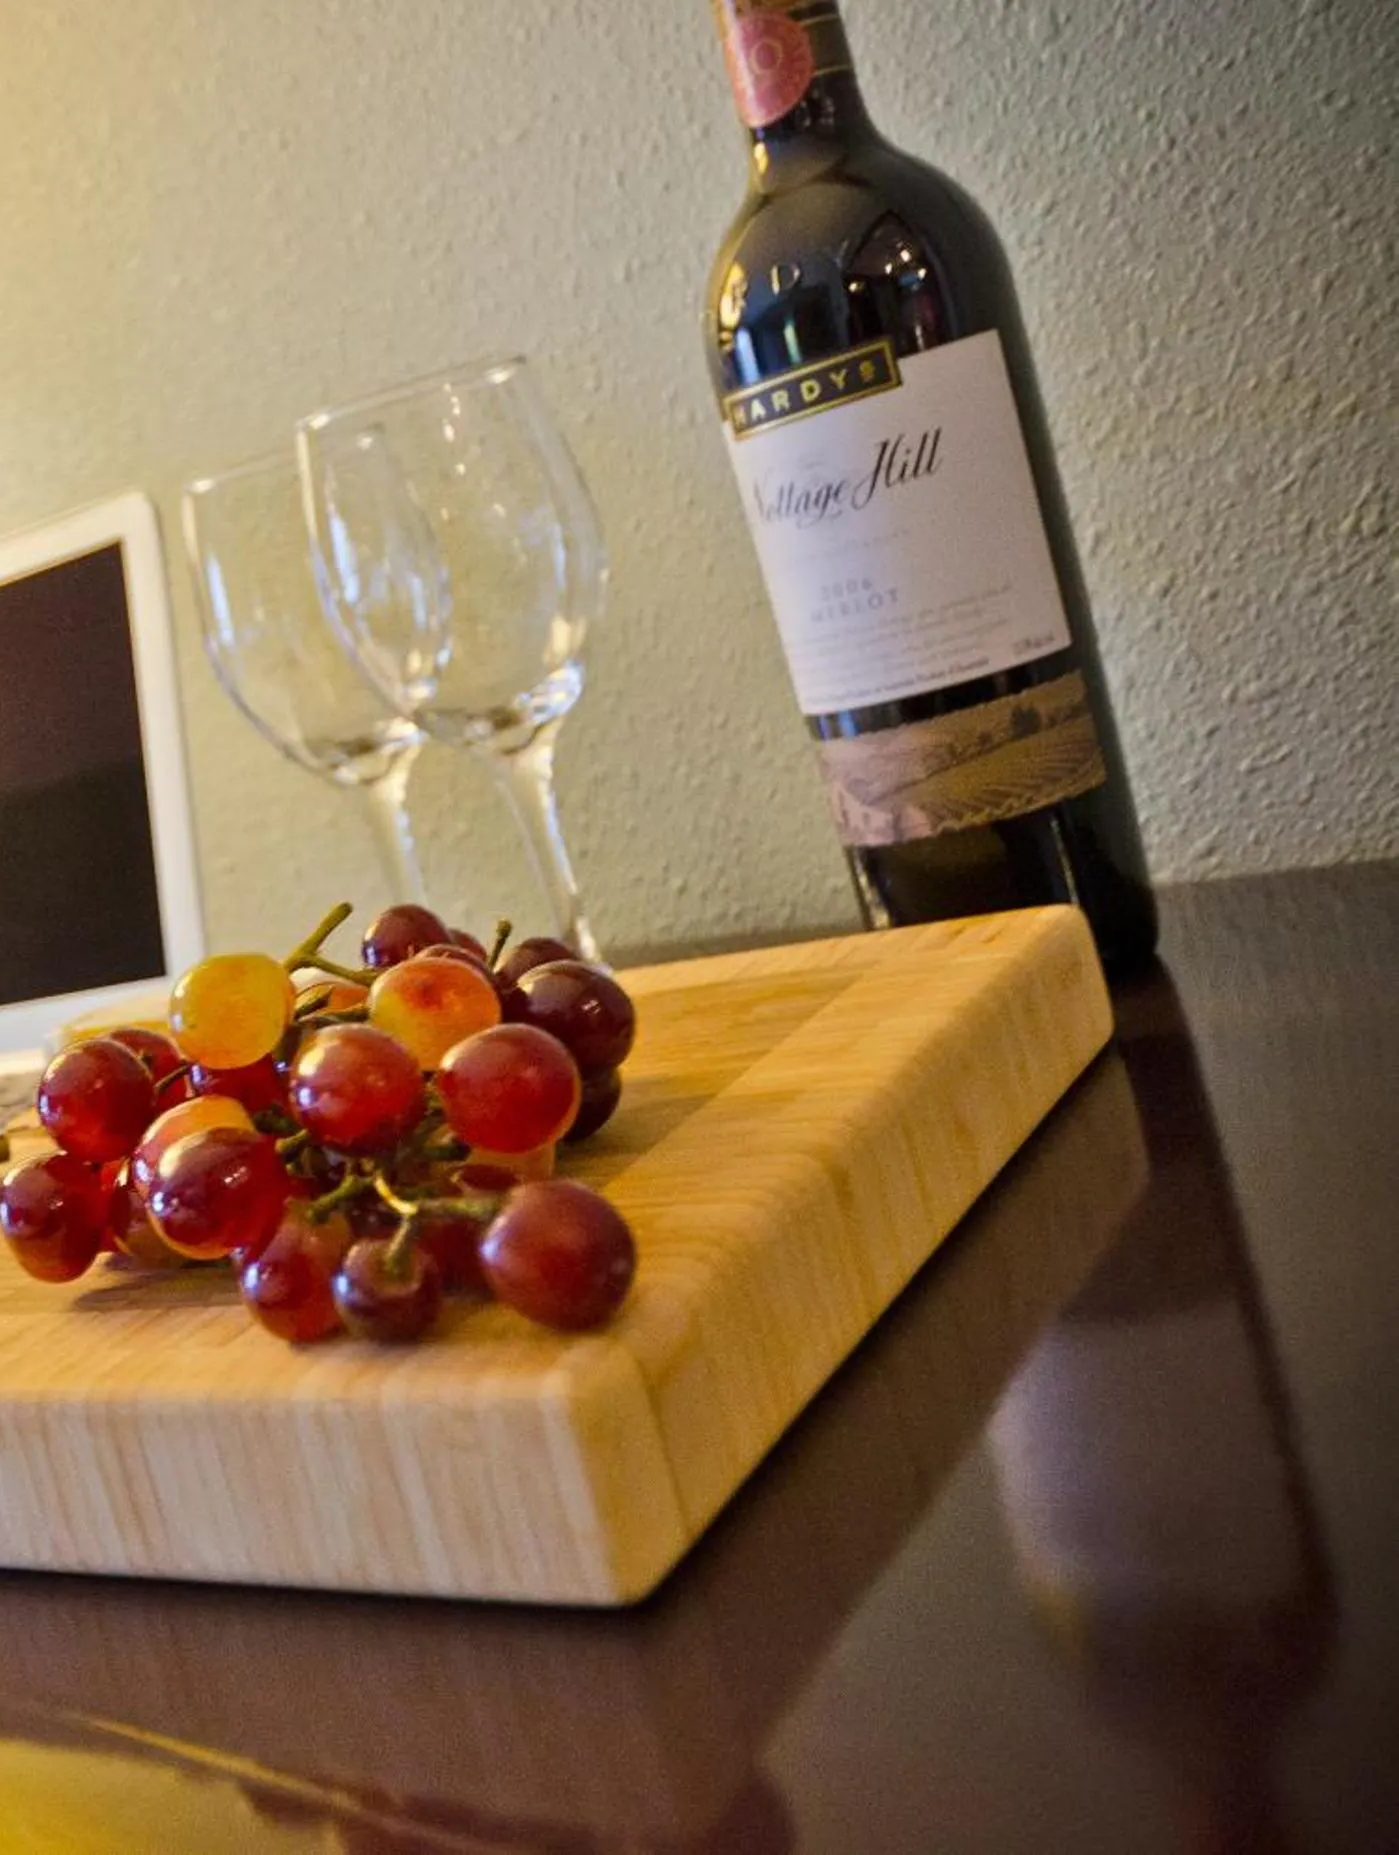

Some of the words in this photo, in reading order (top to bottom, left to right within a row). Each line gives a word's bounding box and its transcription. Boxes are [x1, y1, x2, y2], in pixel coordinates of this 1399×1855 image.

[733, 359, 875, 426] HARDYS
[852, 425, 942, 511] Hill
[809, 587, 899, 624] MERLOT
